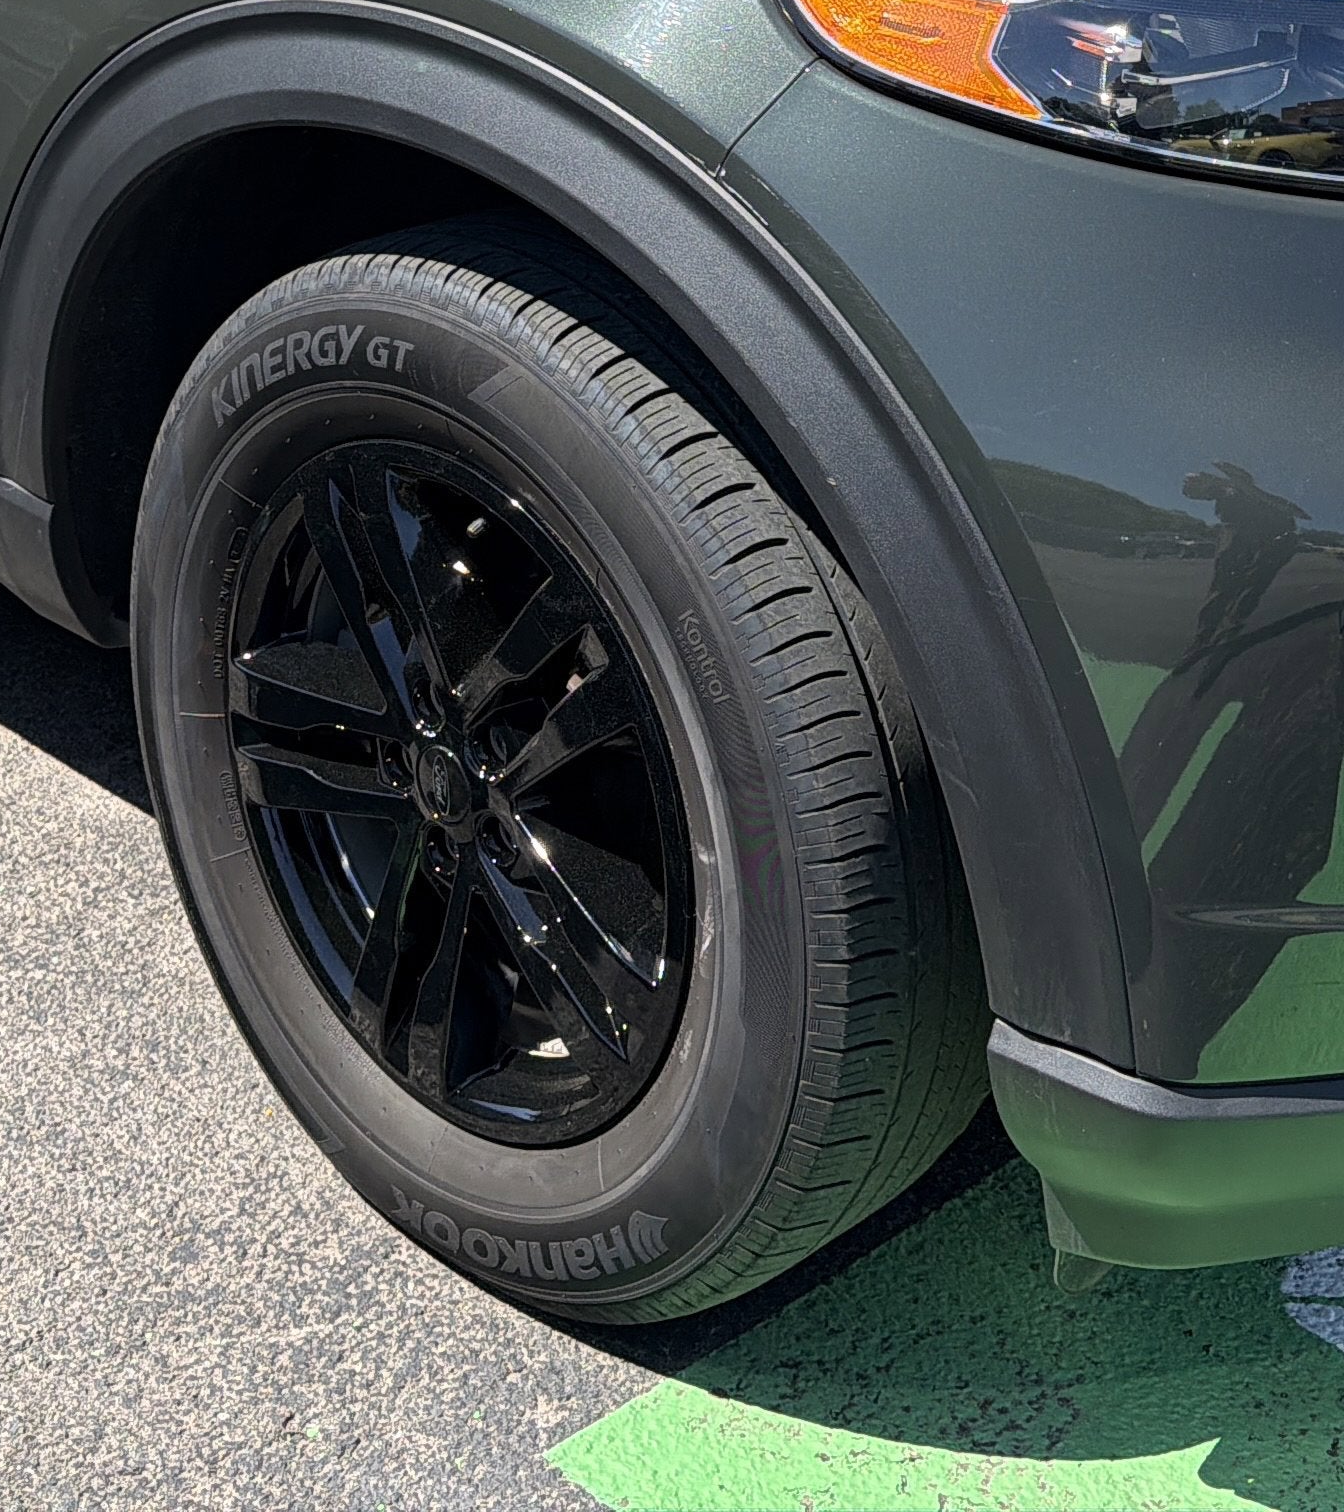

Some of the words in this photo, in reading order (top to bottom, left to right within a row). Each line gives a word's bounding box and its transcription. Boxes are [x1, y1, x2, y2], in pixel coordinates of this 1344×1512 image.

[212, 323, 367, 429] KINERGY
[366, 336, 415, 372] GT
[677, 608, 731, 705] Kontrol
